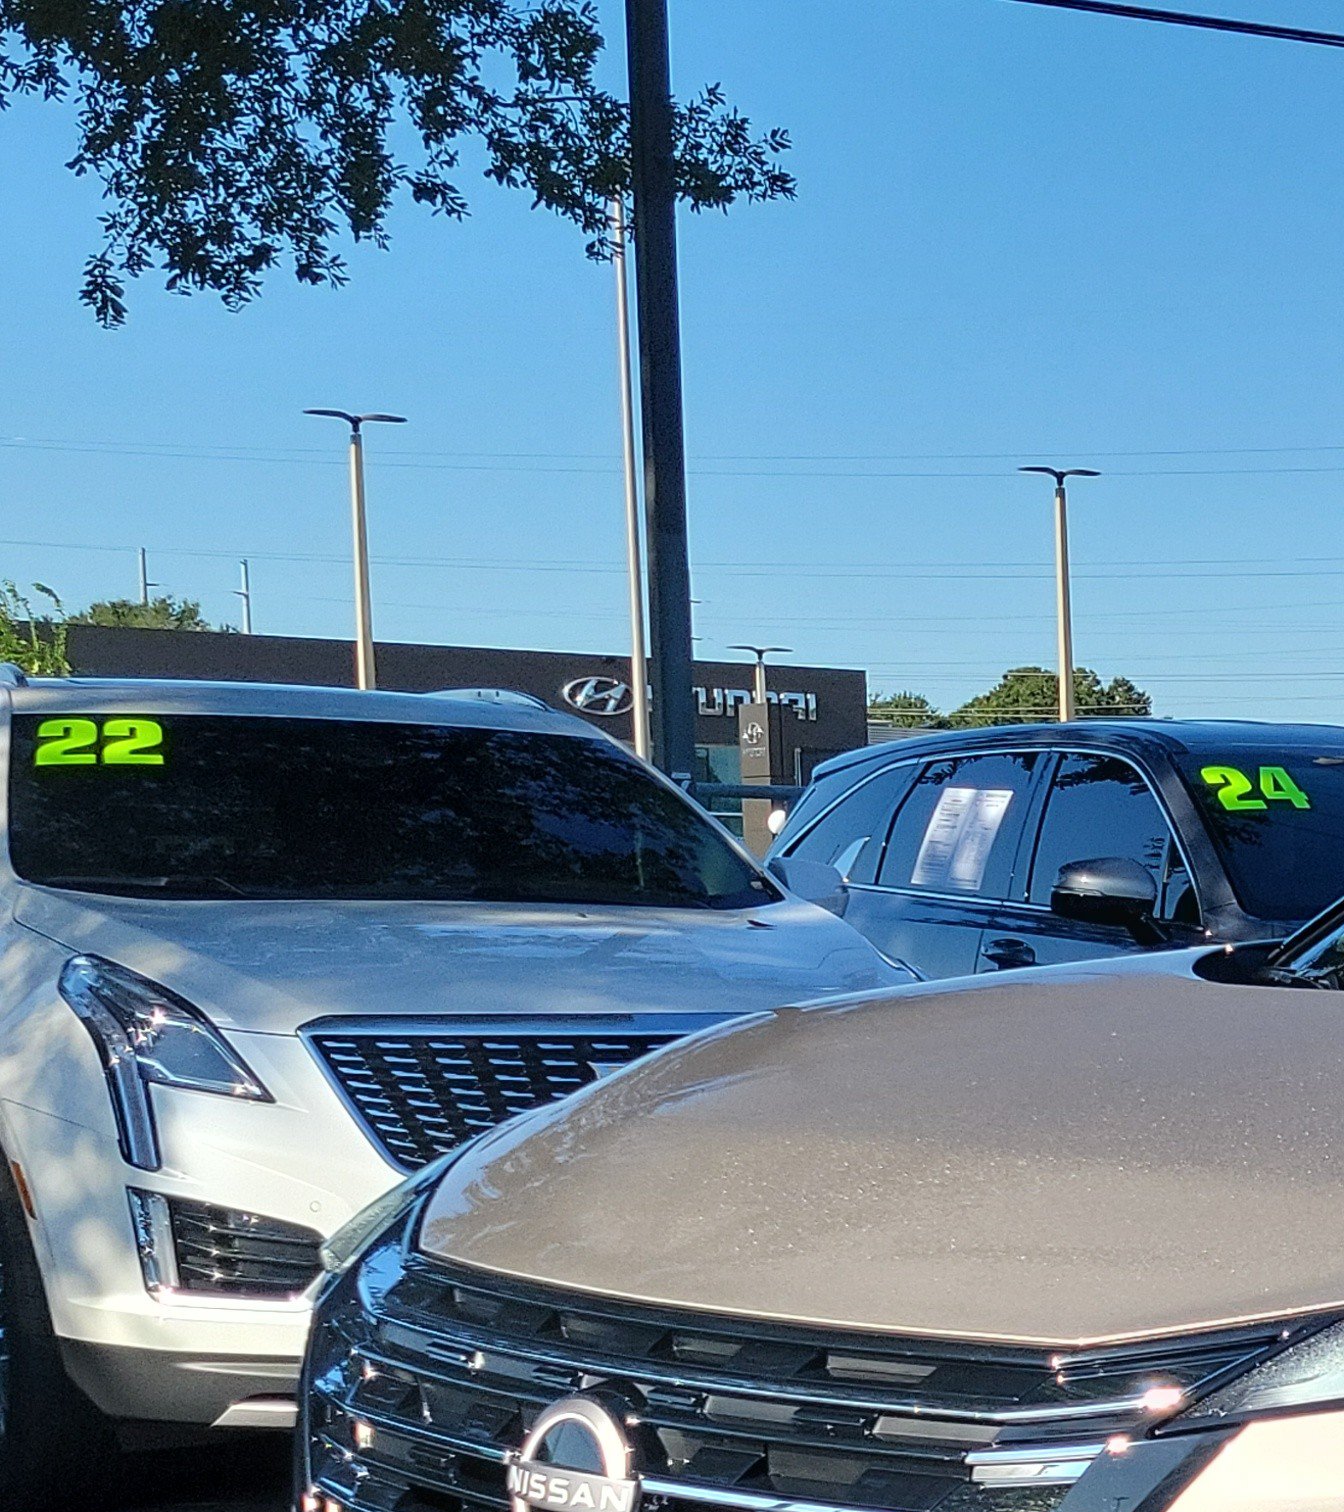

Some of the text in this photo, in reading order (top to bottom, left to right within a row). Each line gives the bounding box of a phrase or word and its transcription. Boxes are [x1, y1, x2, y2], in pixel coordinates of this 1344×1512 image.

[36, 719, 164, 765] 22
[1200, 766, 1311, 811] 24
[509, 1465, 629, 1512] NISSAN
